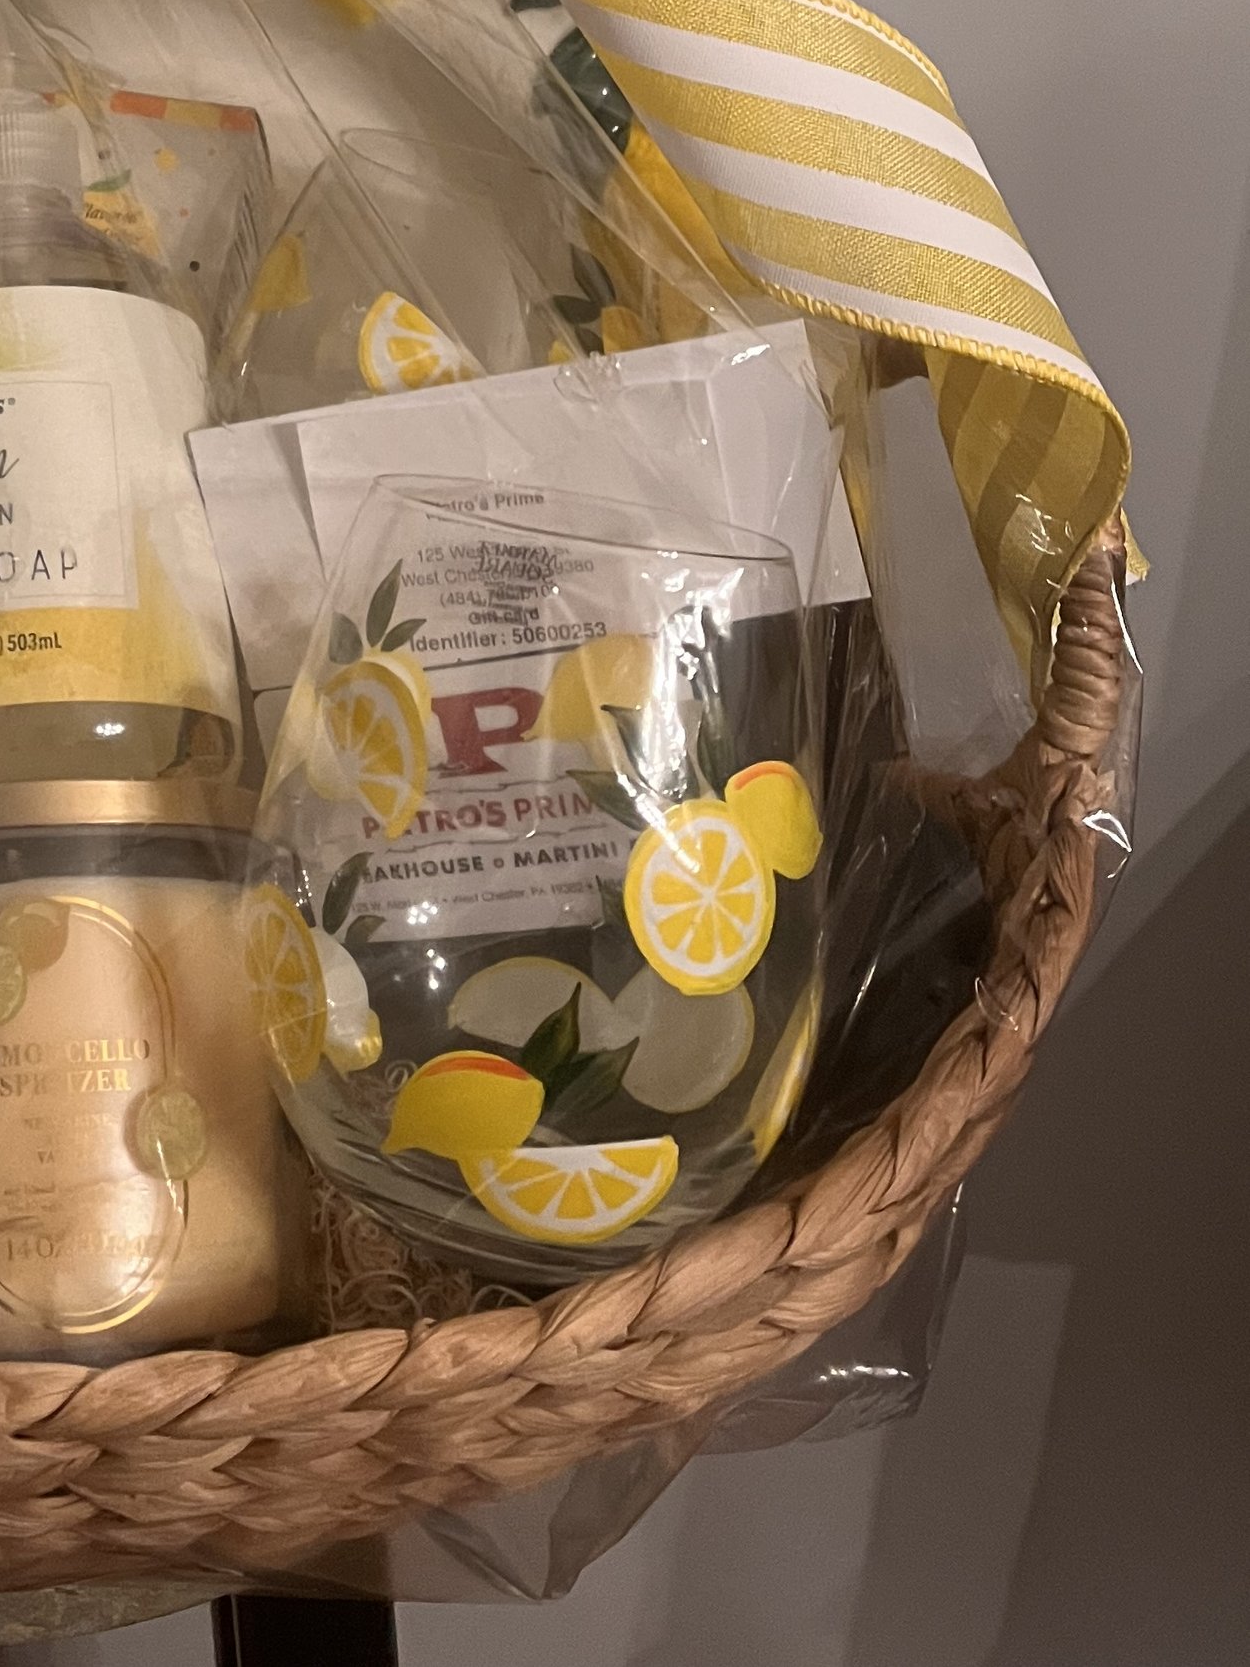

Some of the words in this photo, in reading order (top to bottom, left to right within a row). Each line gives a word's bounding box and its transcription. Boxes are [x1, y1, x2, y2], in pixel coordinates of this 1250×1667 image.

[494, 492, 545, 510] Prime
[417, 545, 444, 564] 125
[401, 569, 440, 588] West
[7, 632, 62, 652] 503mL
[511, 621, 608, 645] 50600253
[430, 686, 544, 778] P
[361, 798, 508, 840] PTRO'S
[512, 840, 619, 869] MARTINI
[0, 1068, 131, 1097] SPRTZER
